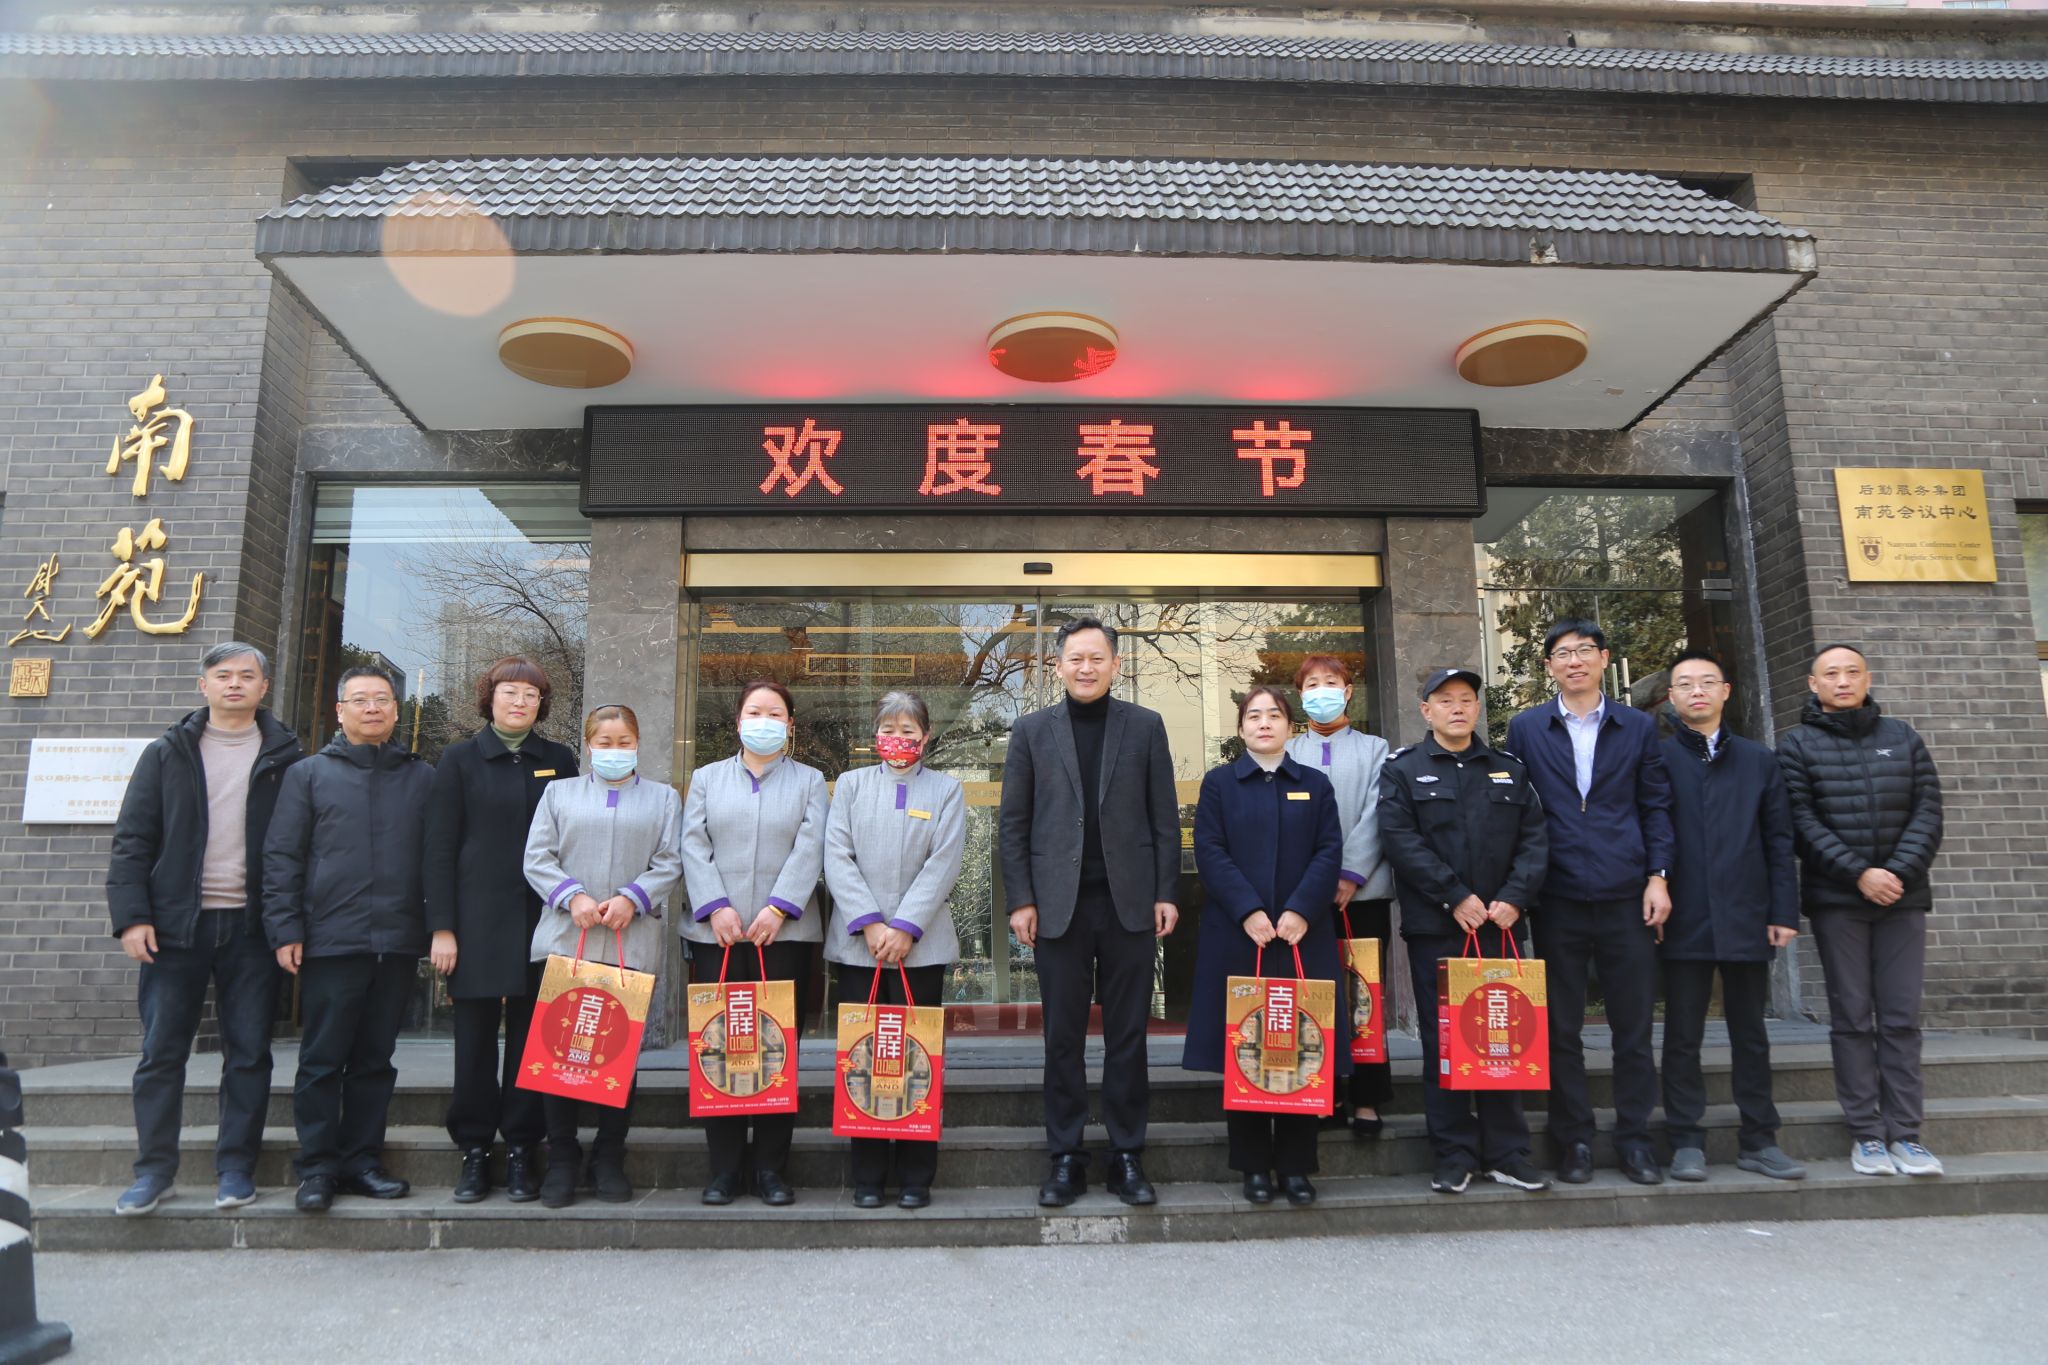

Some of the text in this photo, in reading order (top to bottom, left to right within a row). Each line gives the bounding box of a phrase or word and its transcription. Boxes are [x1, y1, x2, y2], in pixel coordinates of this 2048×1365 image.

[758, 417, 1314, 499] 欢度春节
[1858, 484, 1967, 497] 后勤服务集团
[83, 373, 205, 640] 南苑
[1854, 504, 1978, 520] 南苑会议中心
[1887, 540, 1981, 549] Nanyuan Conference Center
[1894, 553, 1902, 561] of
[1929, 553, 1954, 561] Service
[1956, 553, 1978, 562] Group
